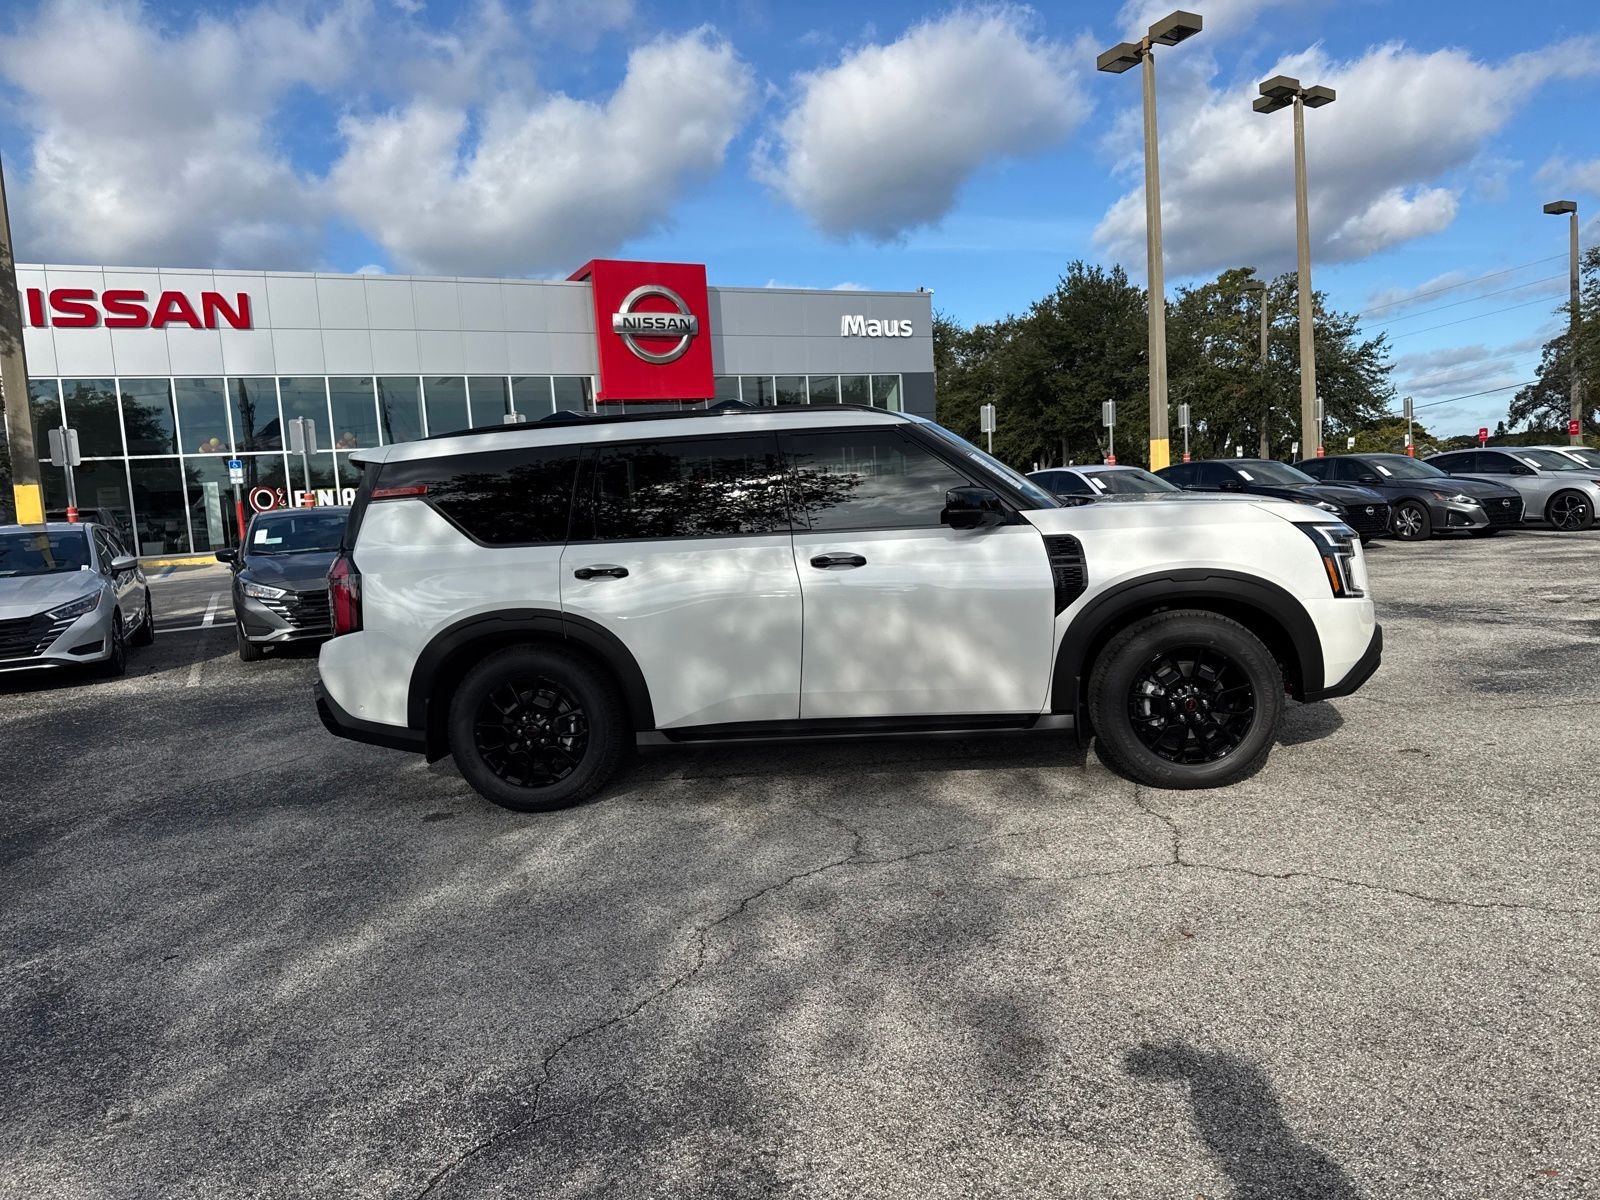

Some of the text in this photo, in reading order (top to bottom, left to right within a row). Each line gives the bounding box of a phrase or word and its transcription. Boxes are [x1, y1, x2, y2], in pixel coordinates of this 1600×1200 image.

[26, 287, 252, 330] ISSAN
[622, 317, 692, 330] NISSAN
[841, 314, 913, 337] Maus
